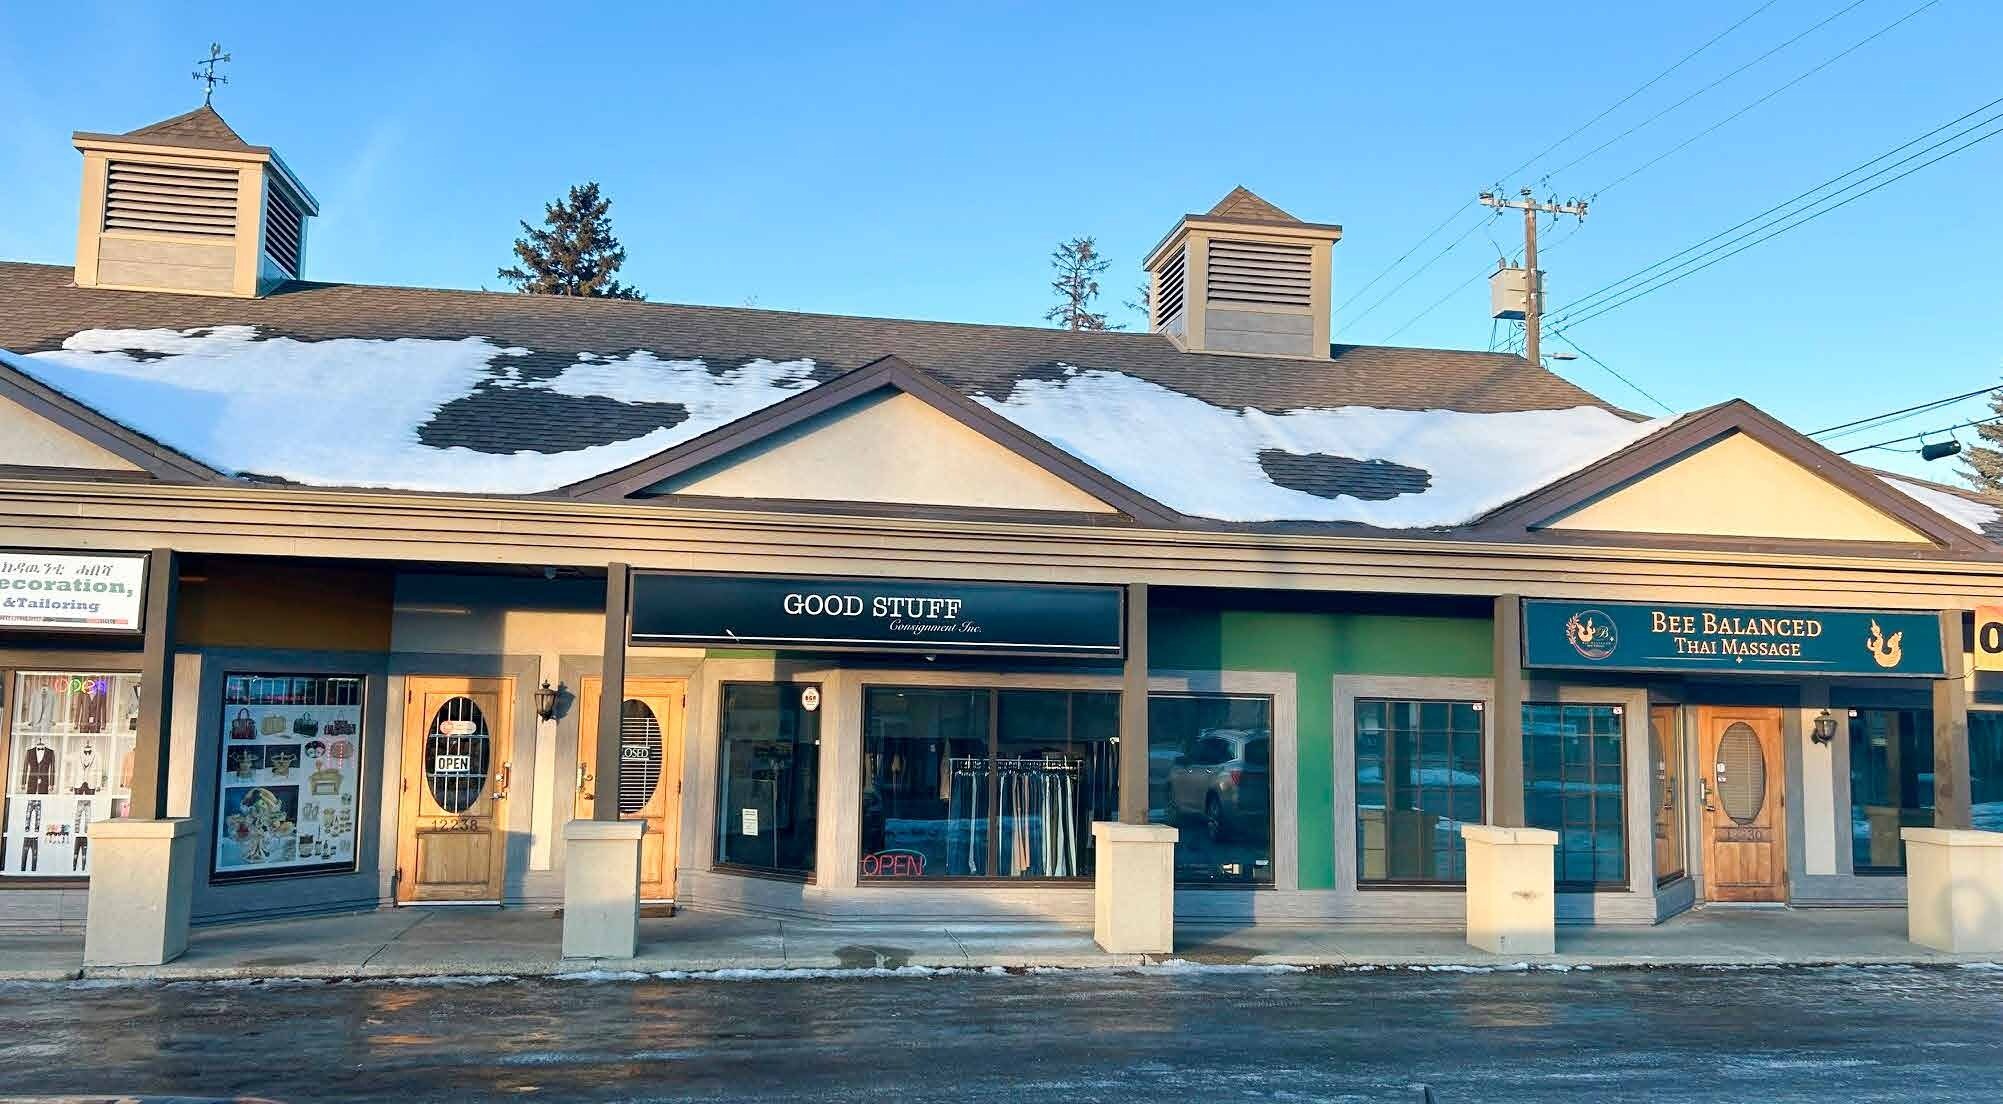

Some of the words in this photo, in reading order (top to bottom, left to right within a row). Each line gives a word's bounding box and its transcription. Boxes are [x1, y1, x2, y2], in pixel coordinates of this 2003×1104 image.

[0, 578, 134, 598] ecoration,
[3, 597, 101, 613] &Tailoring
[783, 593, 864, 616] GOOD
[872, 596, 962, 619] STUFF
[889, 619, 957, 635] Consignment
[959, 621, 983, 633] Inc.
[622, 747, 649, 758] OSED
[438, 757, 469, 770] OPEN
[431, 819, 478, 832] 12238
[863, 855, 922, 876] OPEN
